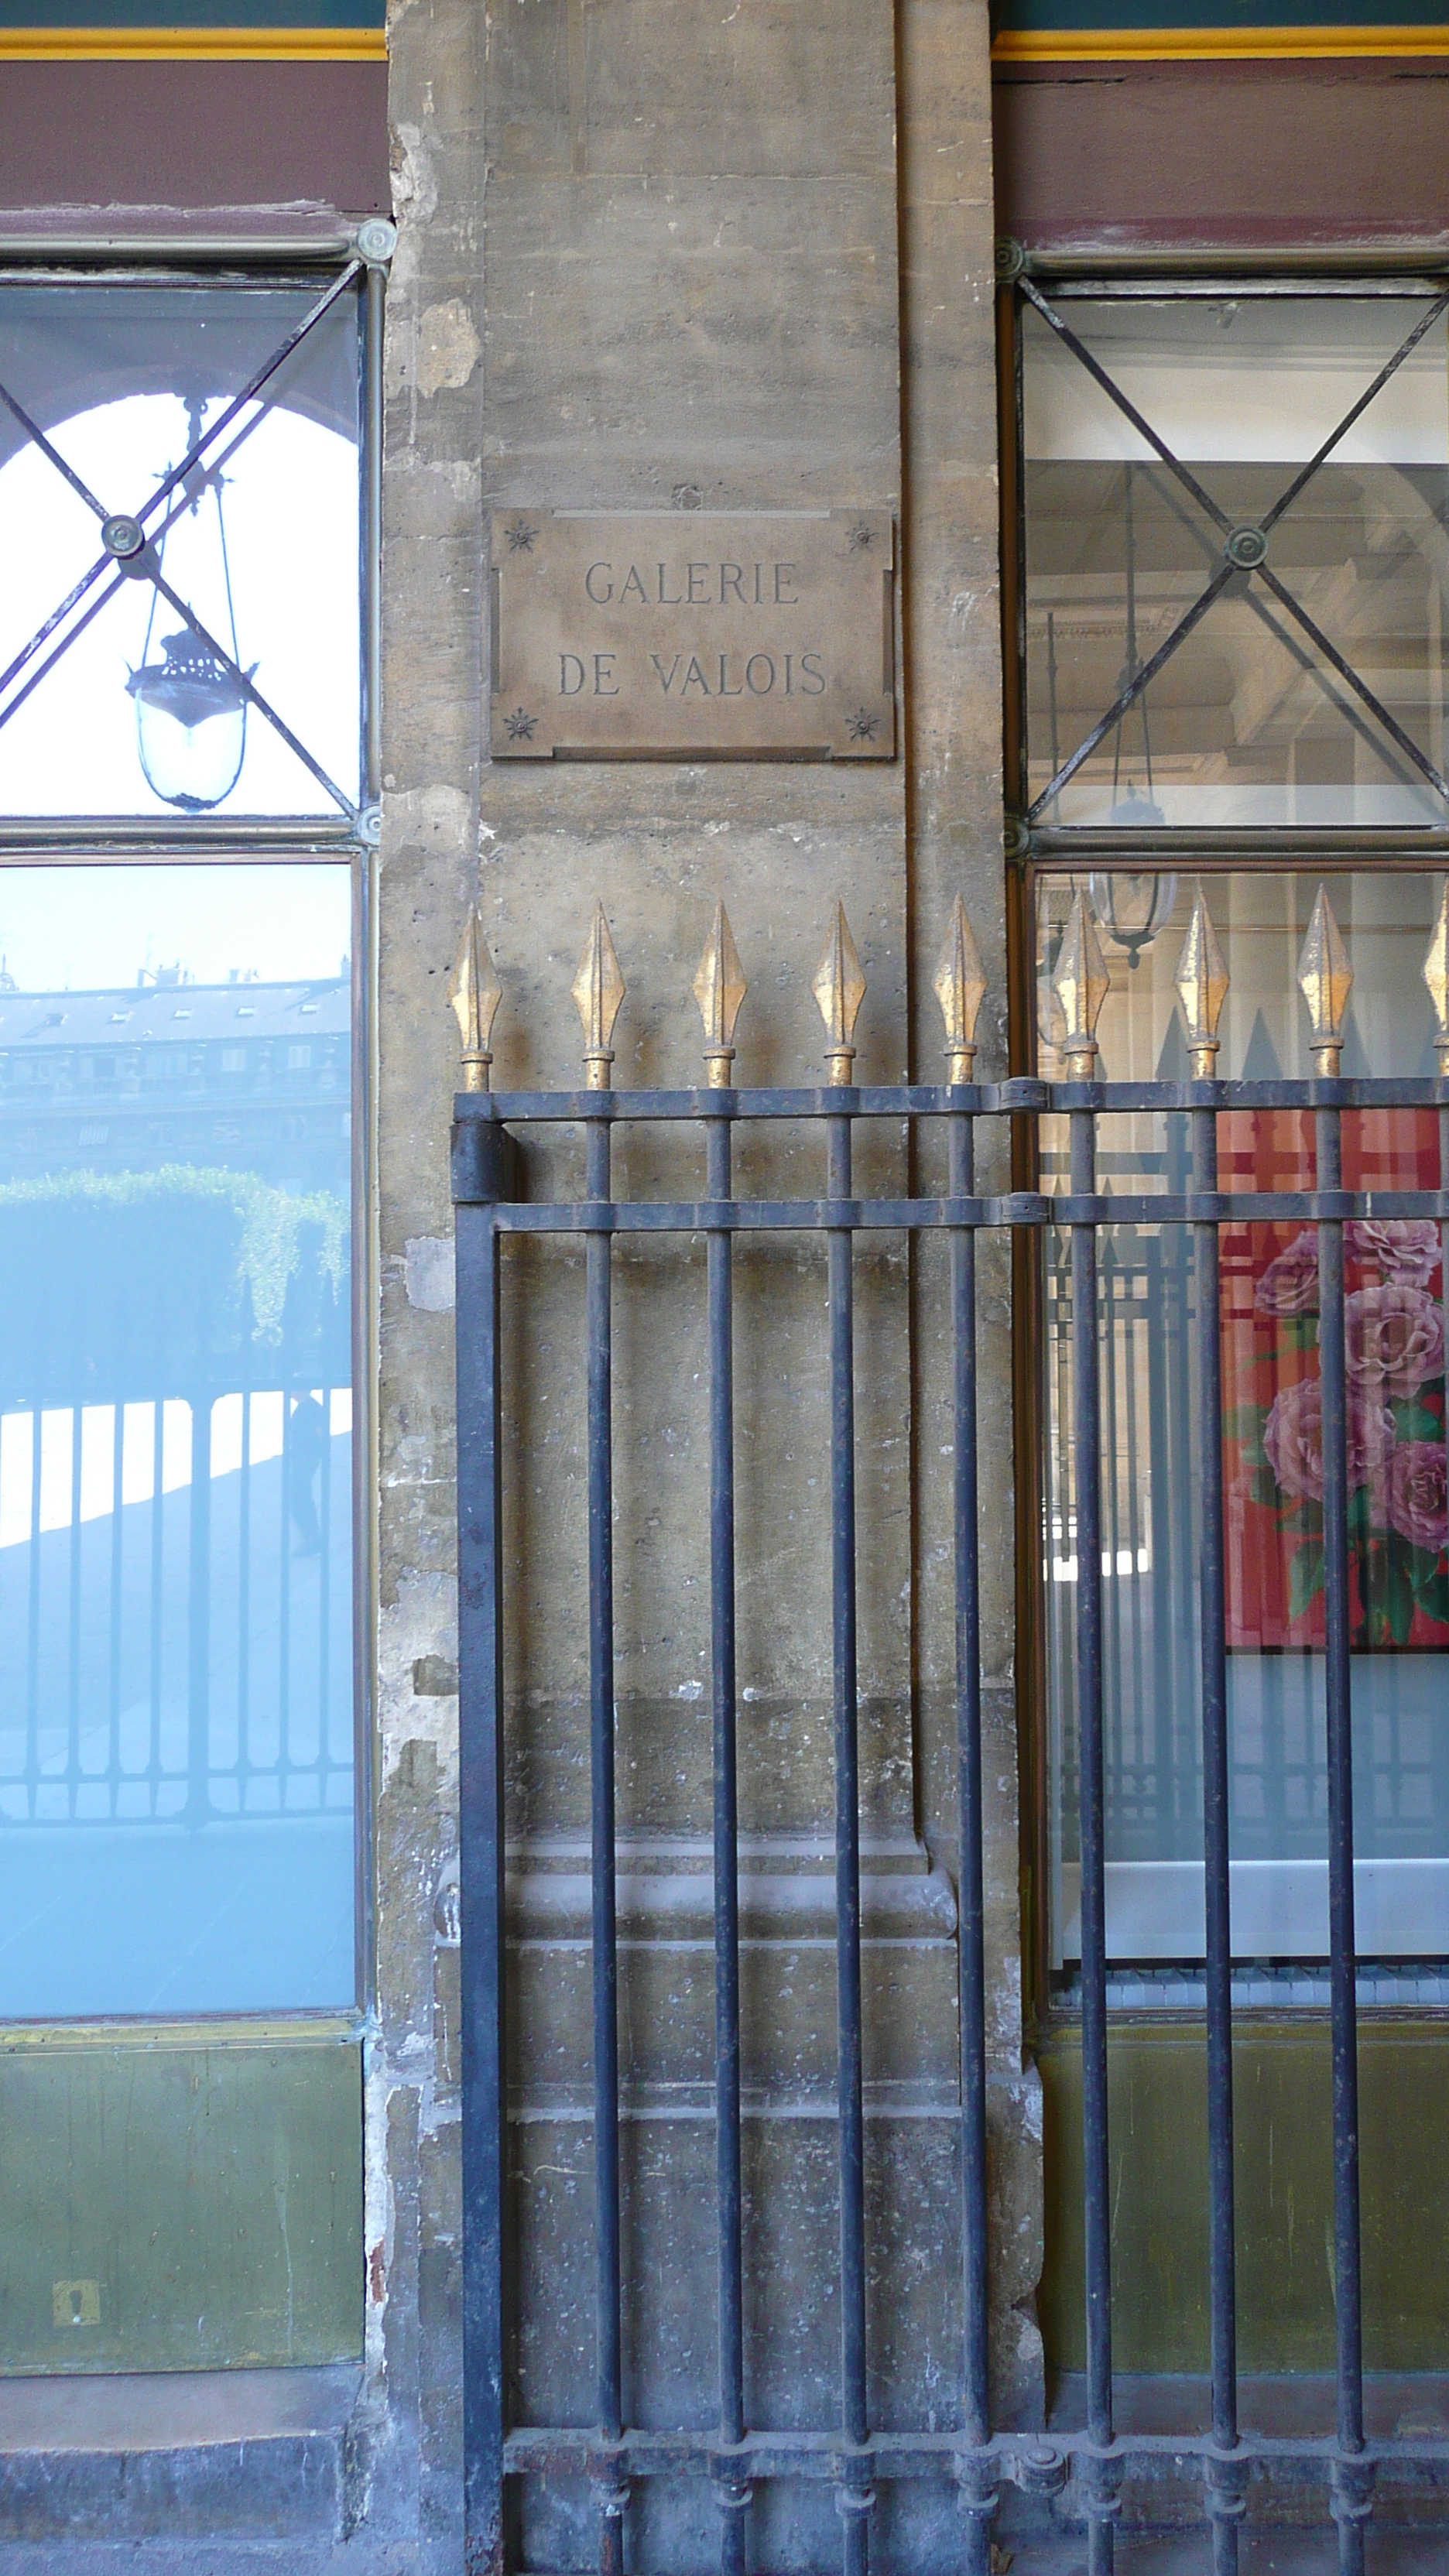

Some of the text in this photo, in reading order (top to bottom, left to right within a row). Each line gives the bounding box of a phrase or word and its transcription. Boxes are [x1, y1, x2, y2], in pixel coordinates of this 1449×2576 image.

[585, 562, 799, 605] GALERIE
[558, 653, 826, 695] DE VALOIS
